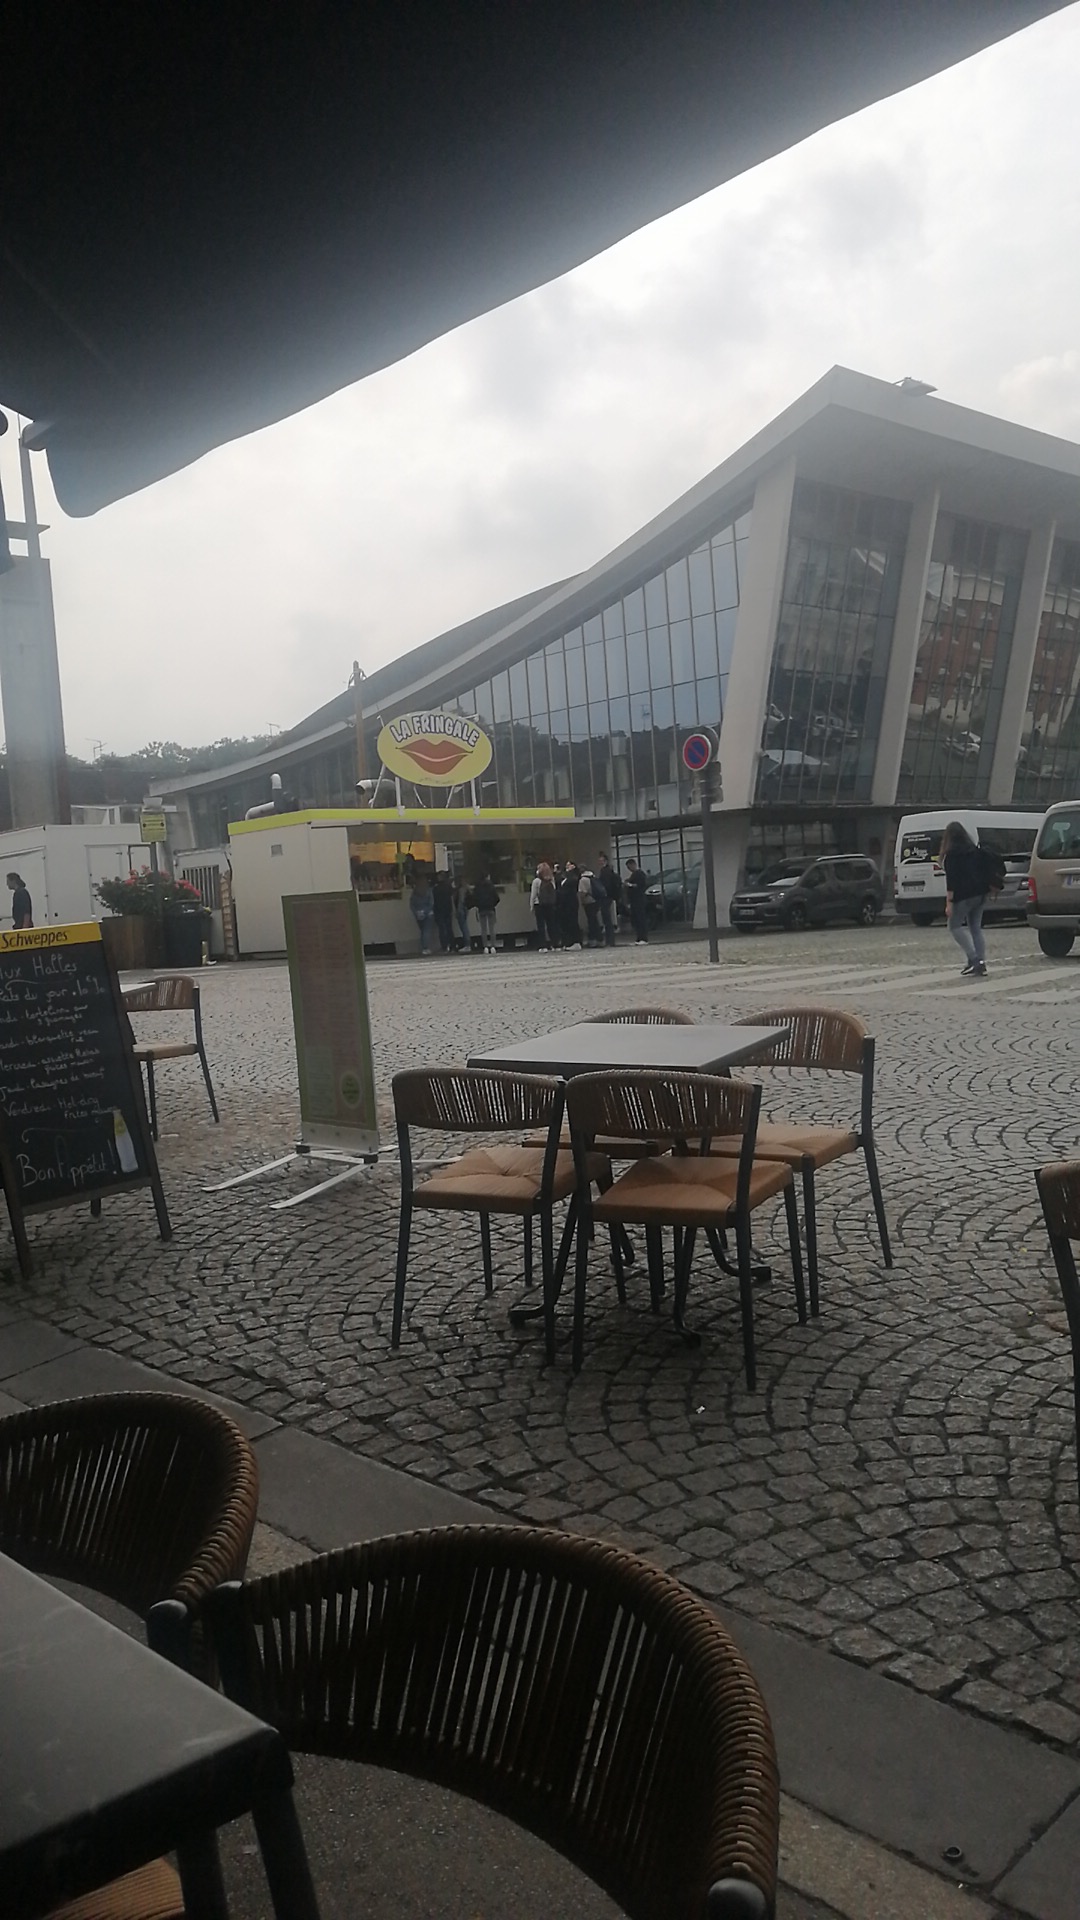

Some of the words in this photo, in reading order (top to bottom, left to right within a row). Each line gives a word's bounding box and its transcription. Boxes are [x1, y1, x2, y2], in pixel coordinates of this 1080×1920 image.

[389, 720, 412, 743] LA
[412, 714, 480, 747] FRINGALE
[1, 931, 69, 949] Schweppes
[16, 1153, 56, 1188] Bon
